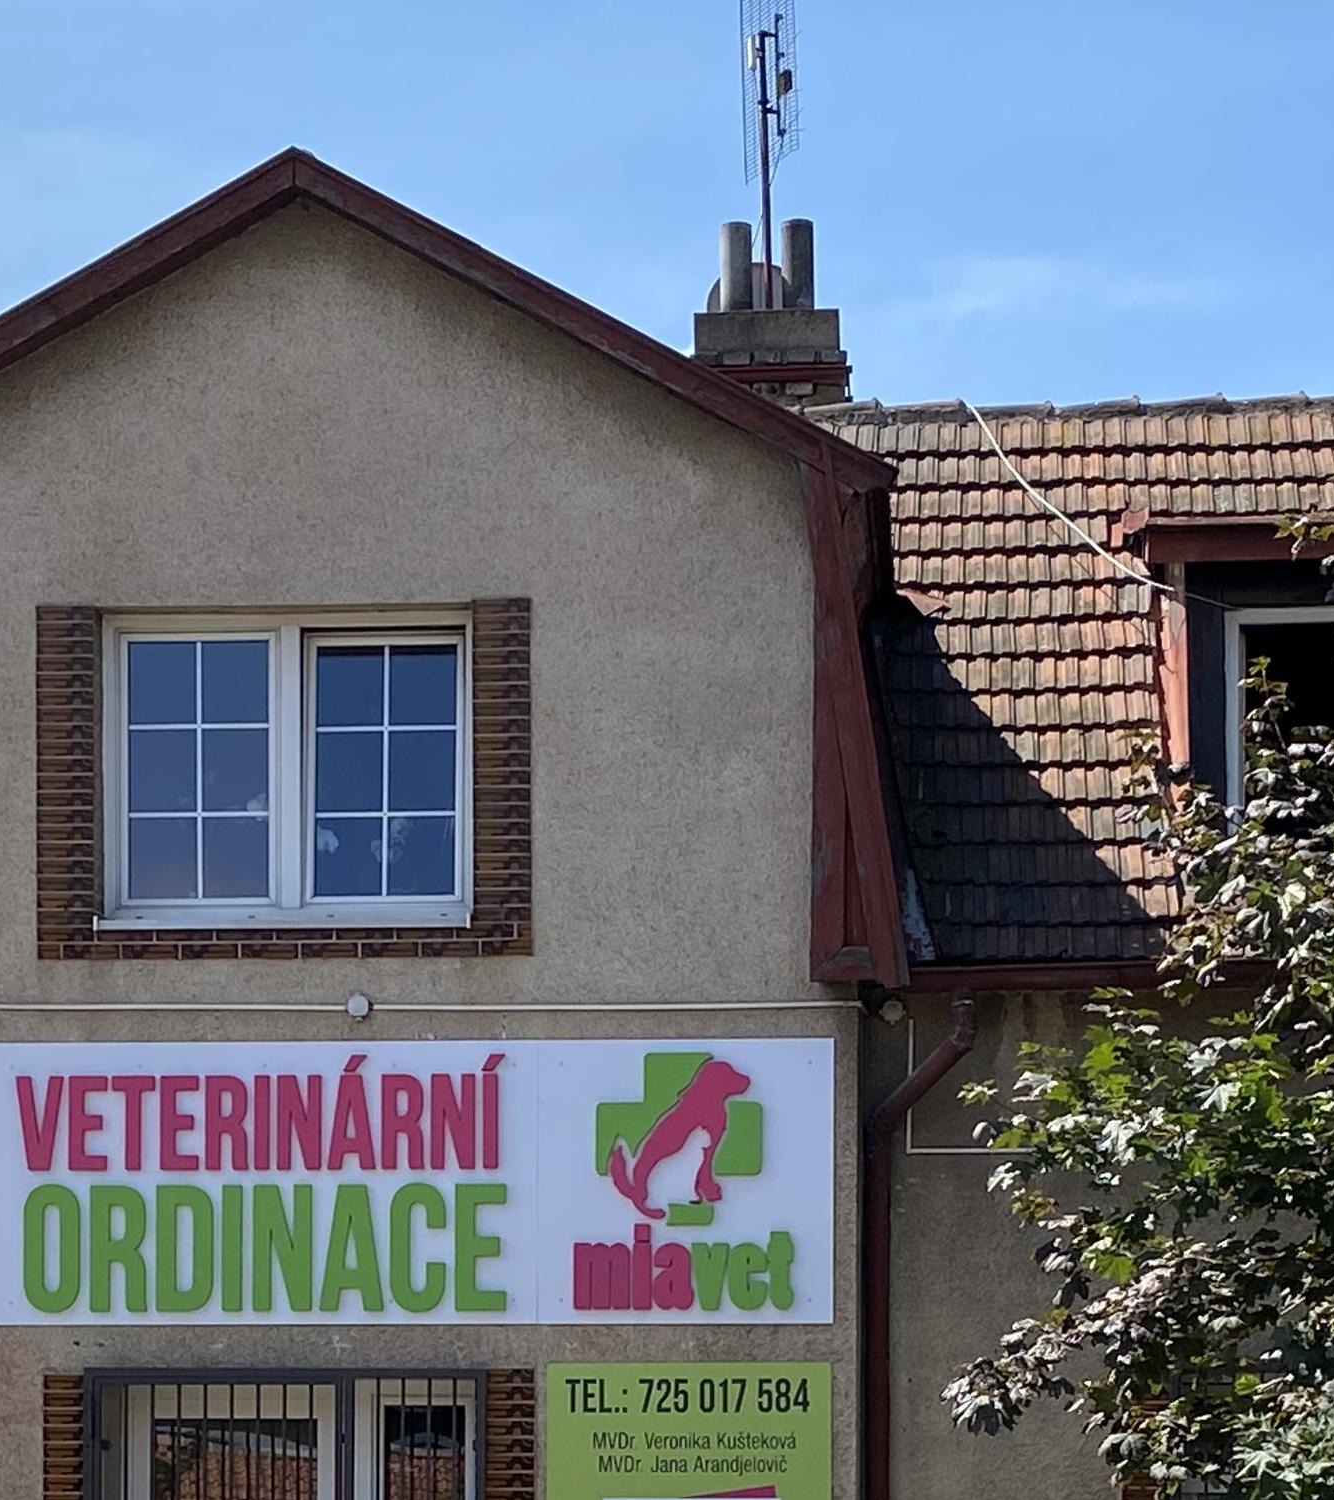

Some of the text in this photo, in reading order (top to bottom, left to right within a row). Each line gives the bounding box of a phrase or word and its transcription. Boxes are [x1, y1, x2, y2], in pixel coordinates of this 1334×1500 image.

[15, 1053, 506, 1172] VETERINÁRNÍ
[23, 1182, 507, 1313] ORDINACE
[573, 1223, 795, 1311] miavet
[565, 1378, 810, 1413] TEL.: 725 017 584
[644, 1431, 711, 1450] Veronika
[650, 1455, 688, 1473] Jana
